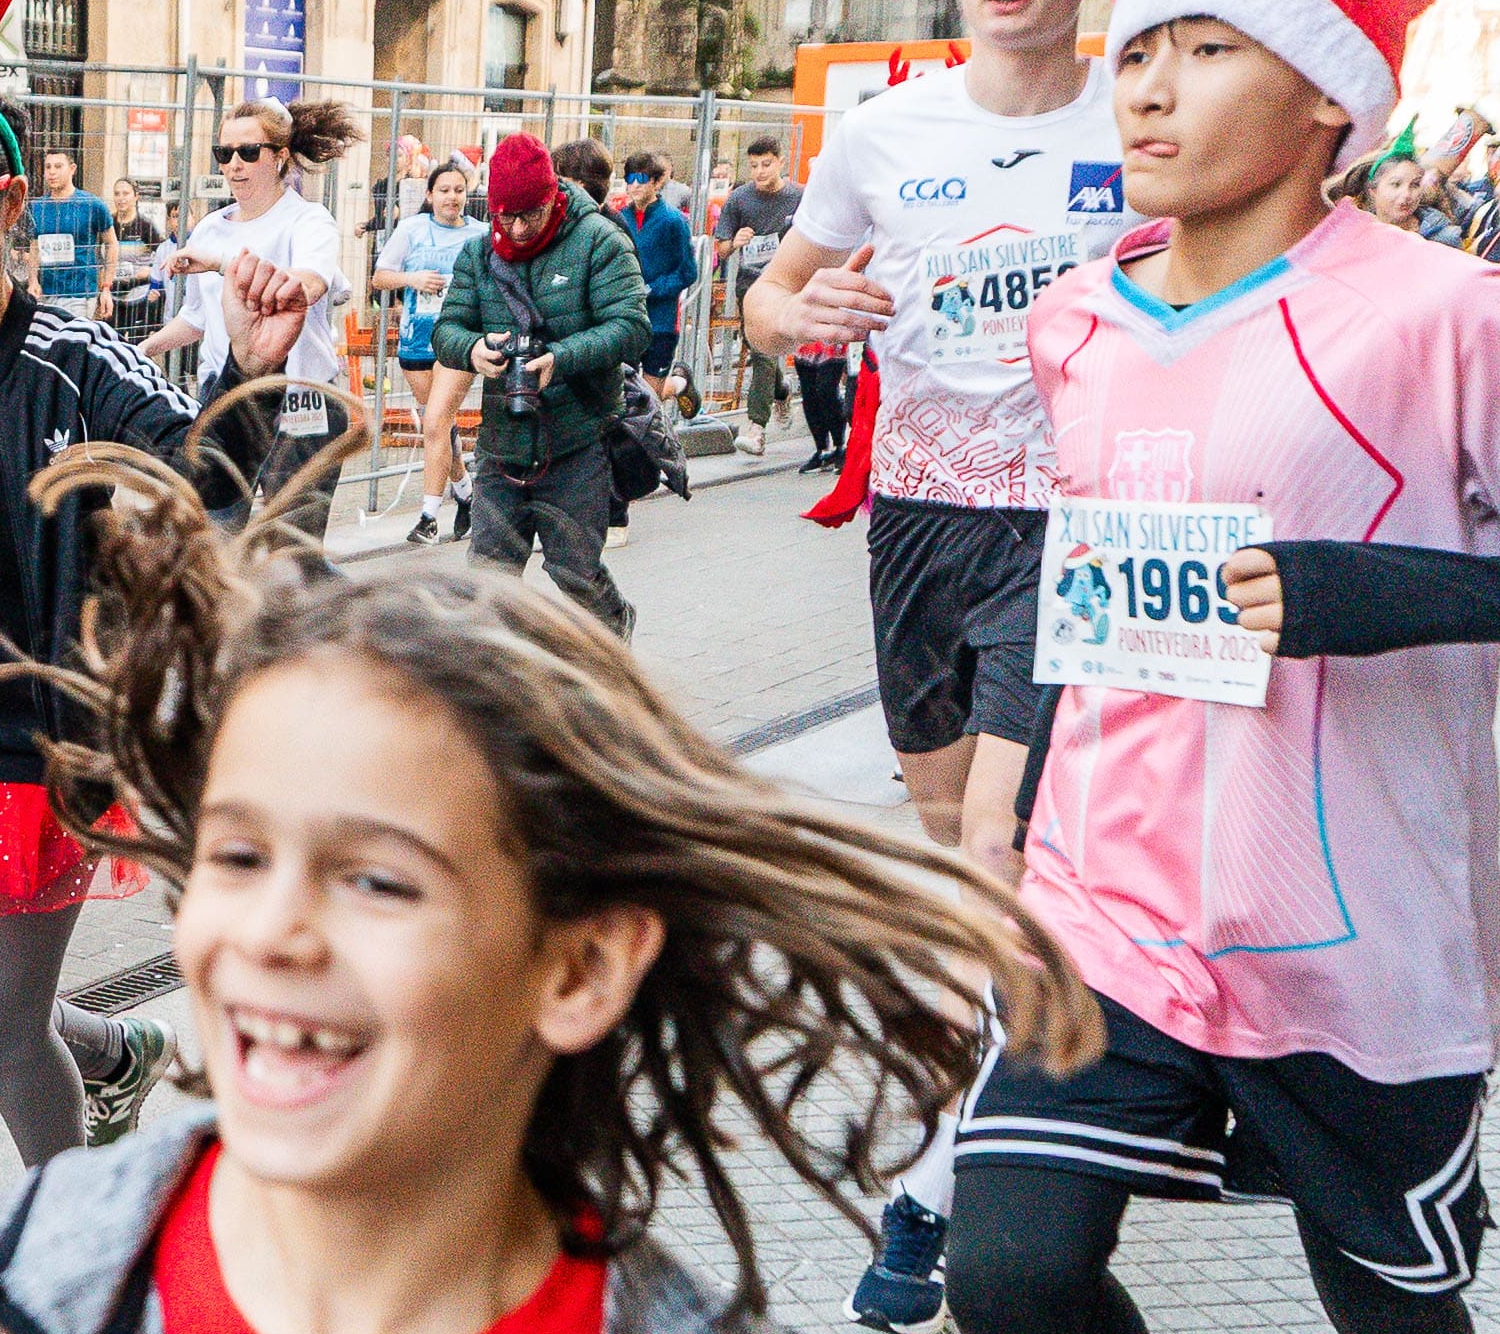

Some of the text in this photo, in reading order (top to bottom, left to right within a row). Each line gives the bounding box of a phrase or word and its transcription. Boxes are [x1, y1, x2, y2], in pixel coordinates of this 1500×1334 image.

[1067, 186, 1117, 210] AXA
[957, 247, 990, 275] SAN
[994, 233, 1079, 269] SILVESTRE
[1092, 511, 1131, 547] SAN
[1139, 513, 1256, 554] SILVESTRE
[1118, 626, 1259, 663] PONTEVEDRA 2025
